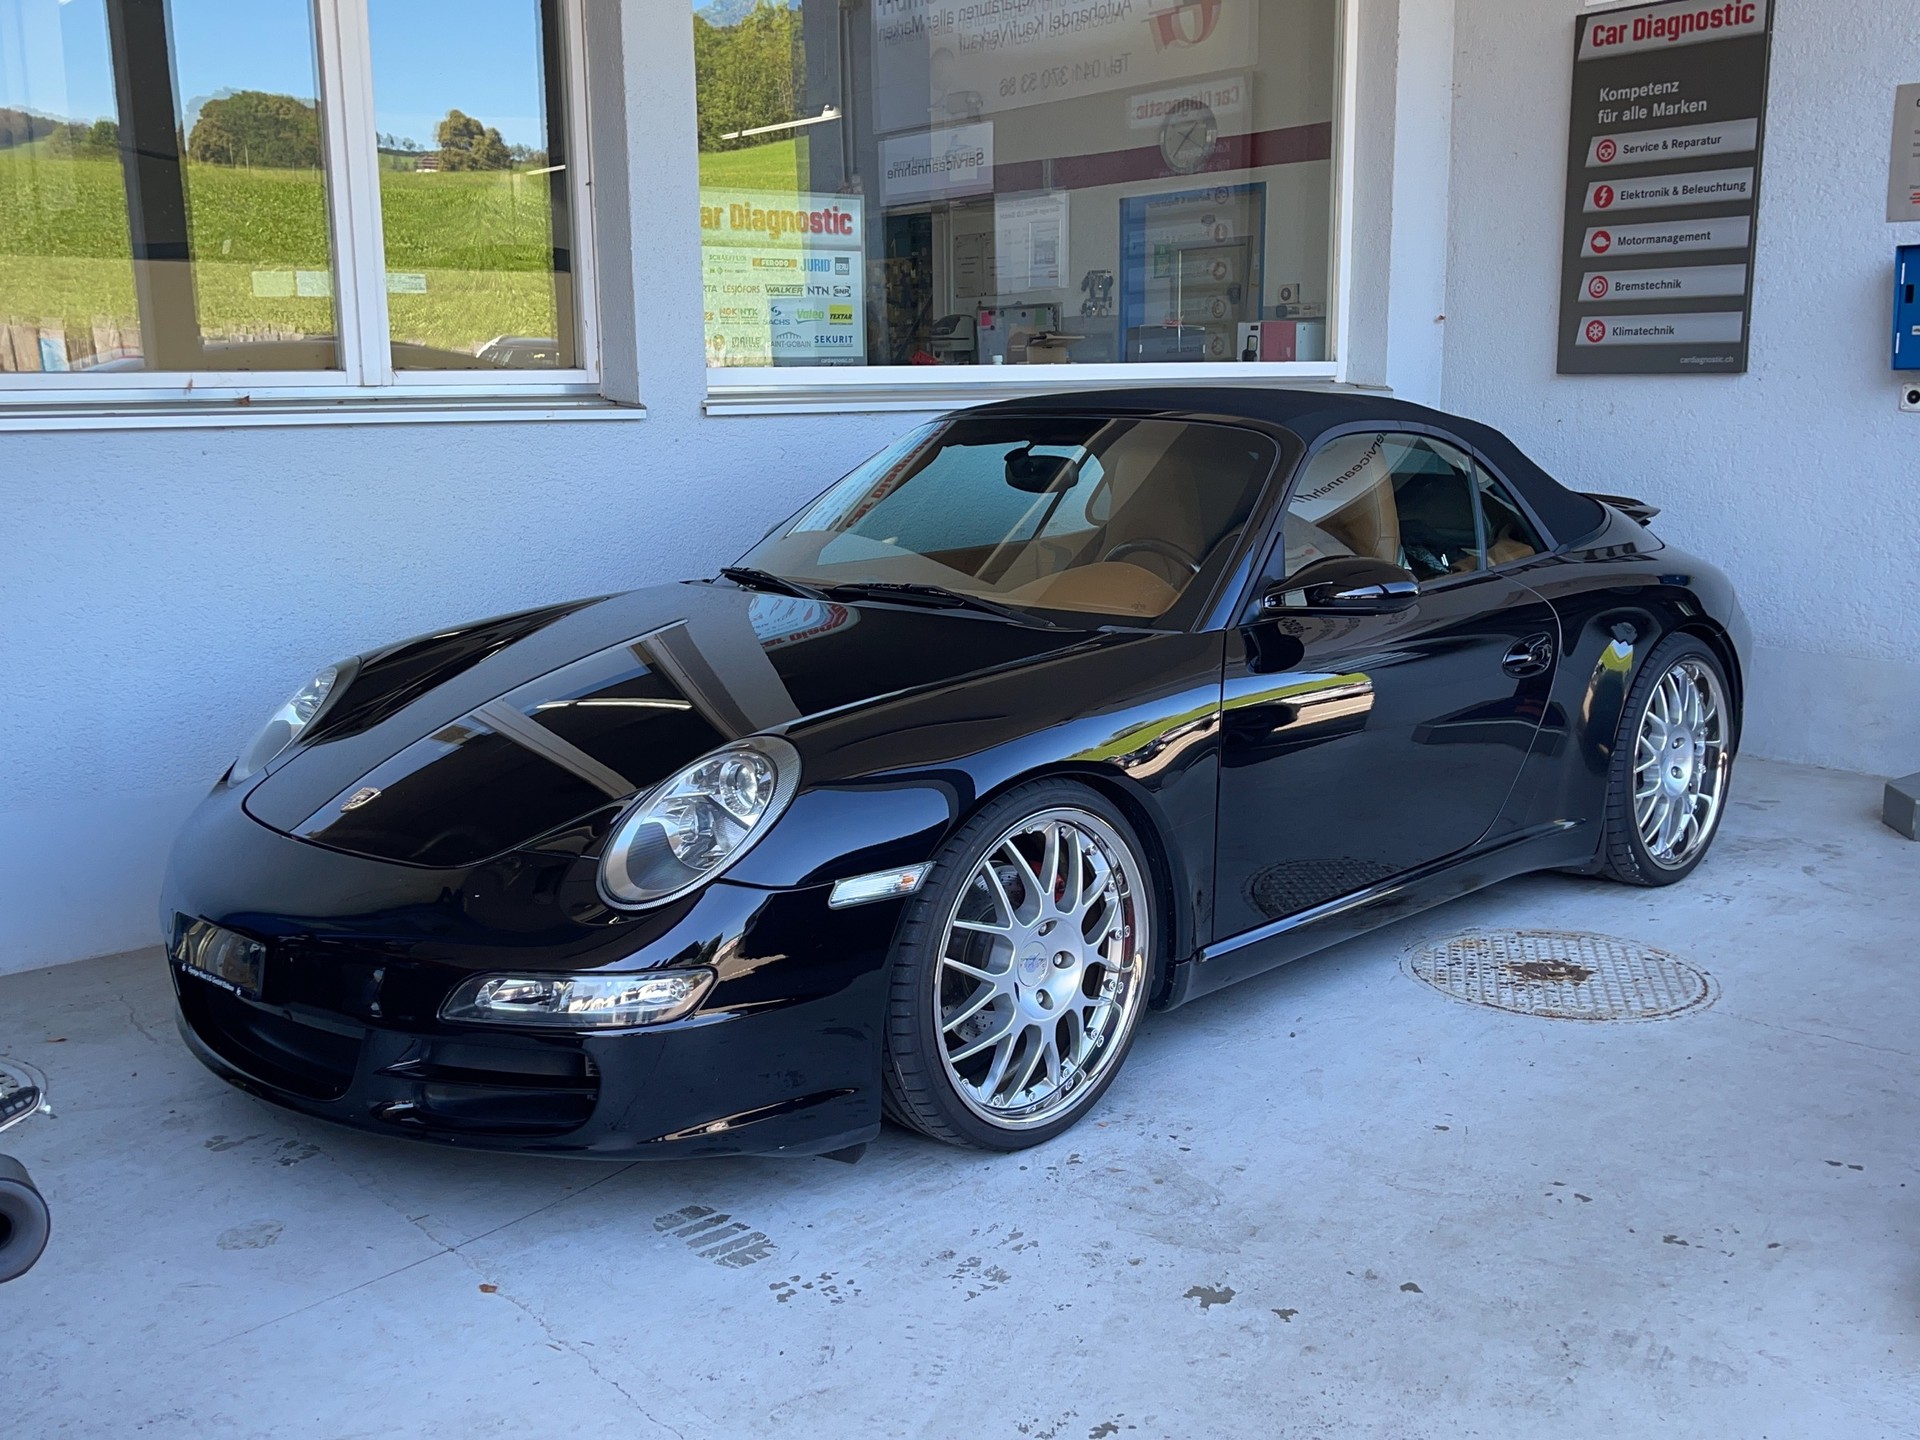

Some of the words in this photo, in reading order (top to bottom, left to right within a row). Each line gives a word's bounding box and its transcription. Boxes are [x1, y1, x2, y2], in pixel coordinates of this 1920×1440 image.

[1591, 23, 1628, 48] Car
[1632, 0, 1756, 42] Diagnostic
[1599, 80, 1680, 102] Kompetenz
[1598, 108, 1618, 125] für
[1622, 104, 1648, 121] alle
[1652, 98, 1708, 118] Marken
[1623, 142, 1660, 155] Service
[1661, 139, 1669, 151] &
[1671, 135, 1723, 150] Reparatur
[1620, 186, 1670, 201] Elektronik
[1672, 184, 1680, 196] &
[1681, 181, 1747, 196] Beleuchtung
[729, 201, 853, 240] Diagnostic
[1617, 231, 1712, 247] Motormanagement
[800, 258, 832, 273] JURID
[765, 286, 804, 295] WALKER
[807, 286, 830, 296] NTN
[1614, 279, 1683, 292] Bremstechnik
[1612, 325, 1675, 337] Klimatechnik
[769, 340, 812, 348] AINT-GOBAIN
[814, 335, 854, 344] SEKURIT
